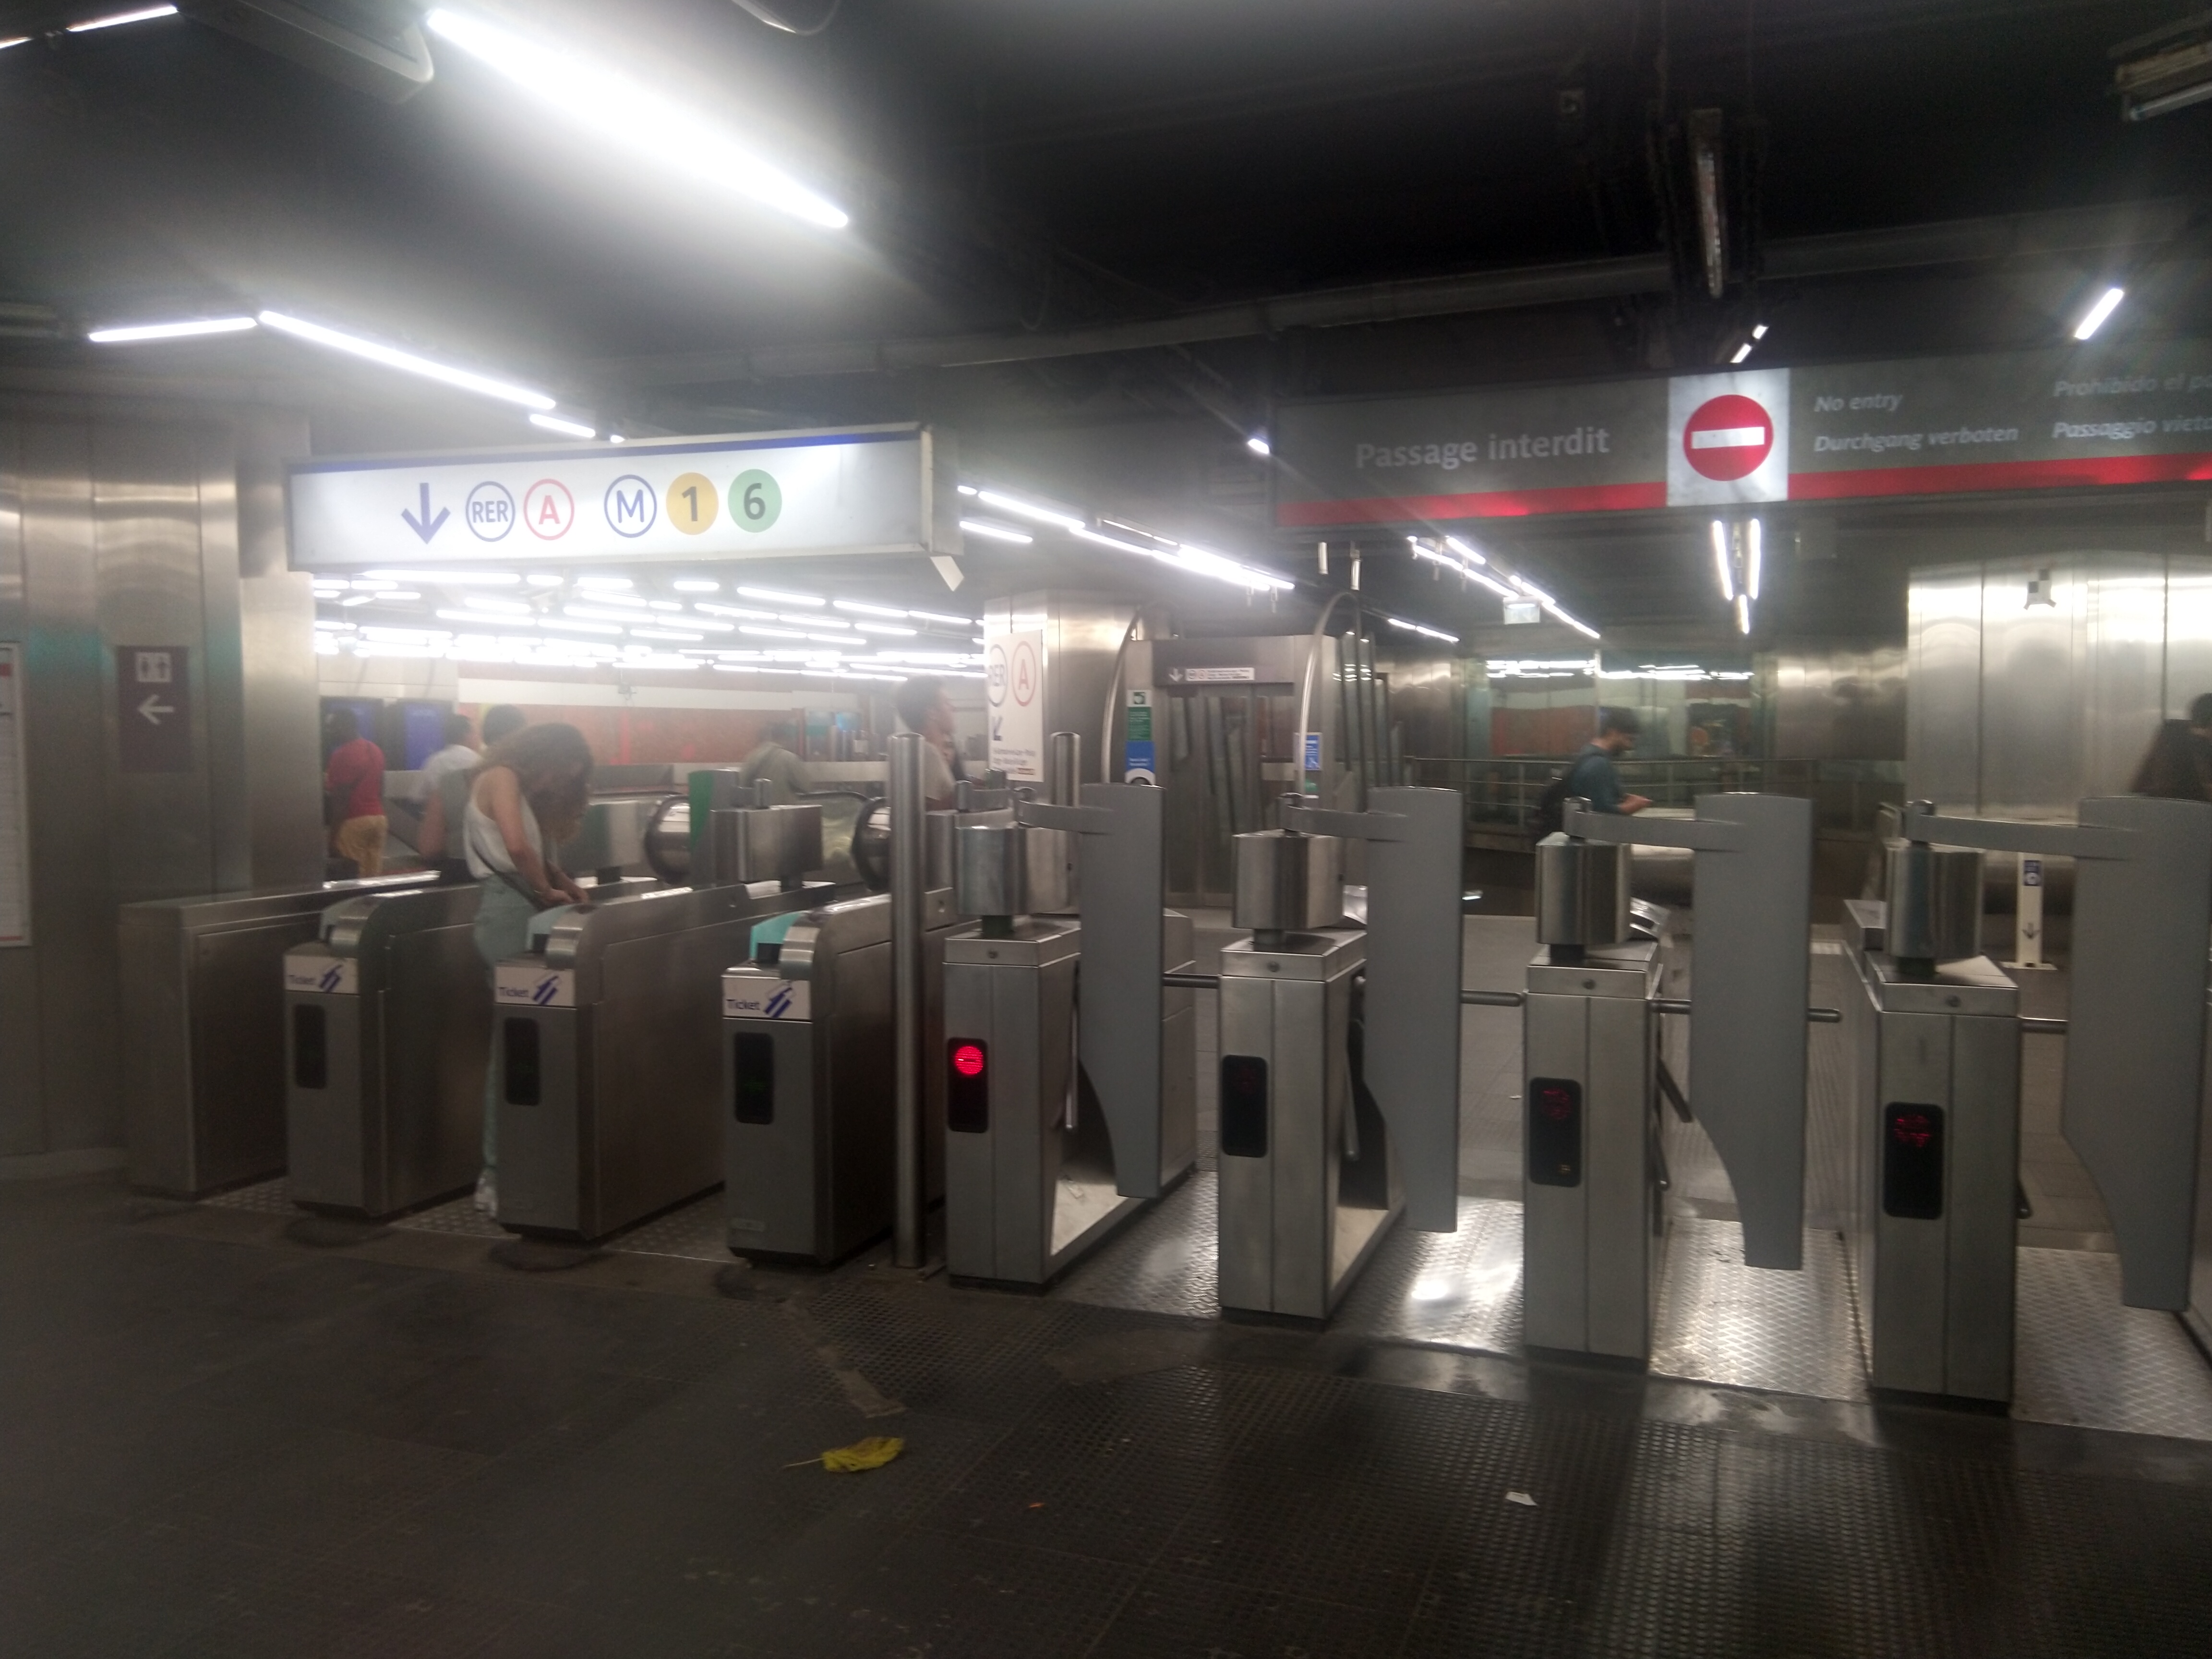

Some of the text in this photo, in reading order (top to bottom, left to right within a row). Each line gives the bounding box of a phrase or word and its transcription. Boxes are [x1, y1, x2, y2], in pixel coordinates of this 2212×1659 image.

[1814, 393, 1903, 412] No entry
[1814, 427, 2018, 452] Durchgang verboten
[2051, 417, 2157, 440] Passaggio
[1356, 427, 1610, 470] Passage interdit
[472, 483, 765, 525] RER A M 1 6
[1018, 659, 1029, 690] A
[499, 986, 529, 998] Ticket
[726, 999, 760, 1010] Ticket
